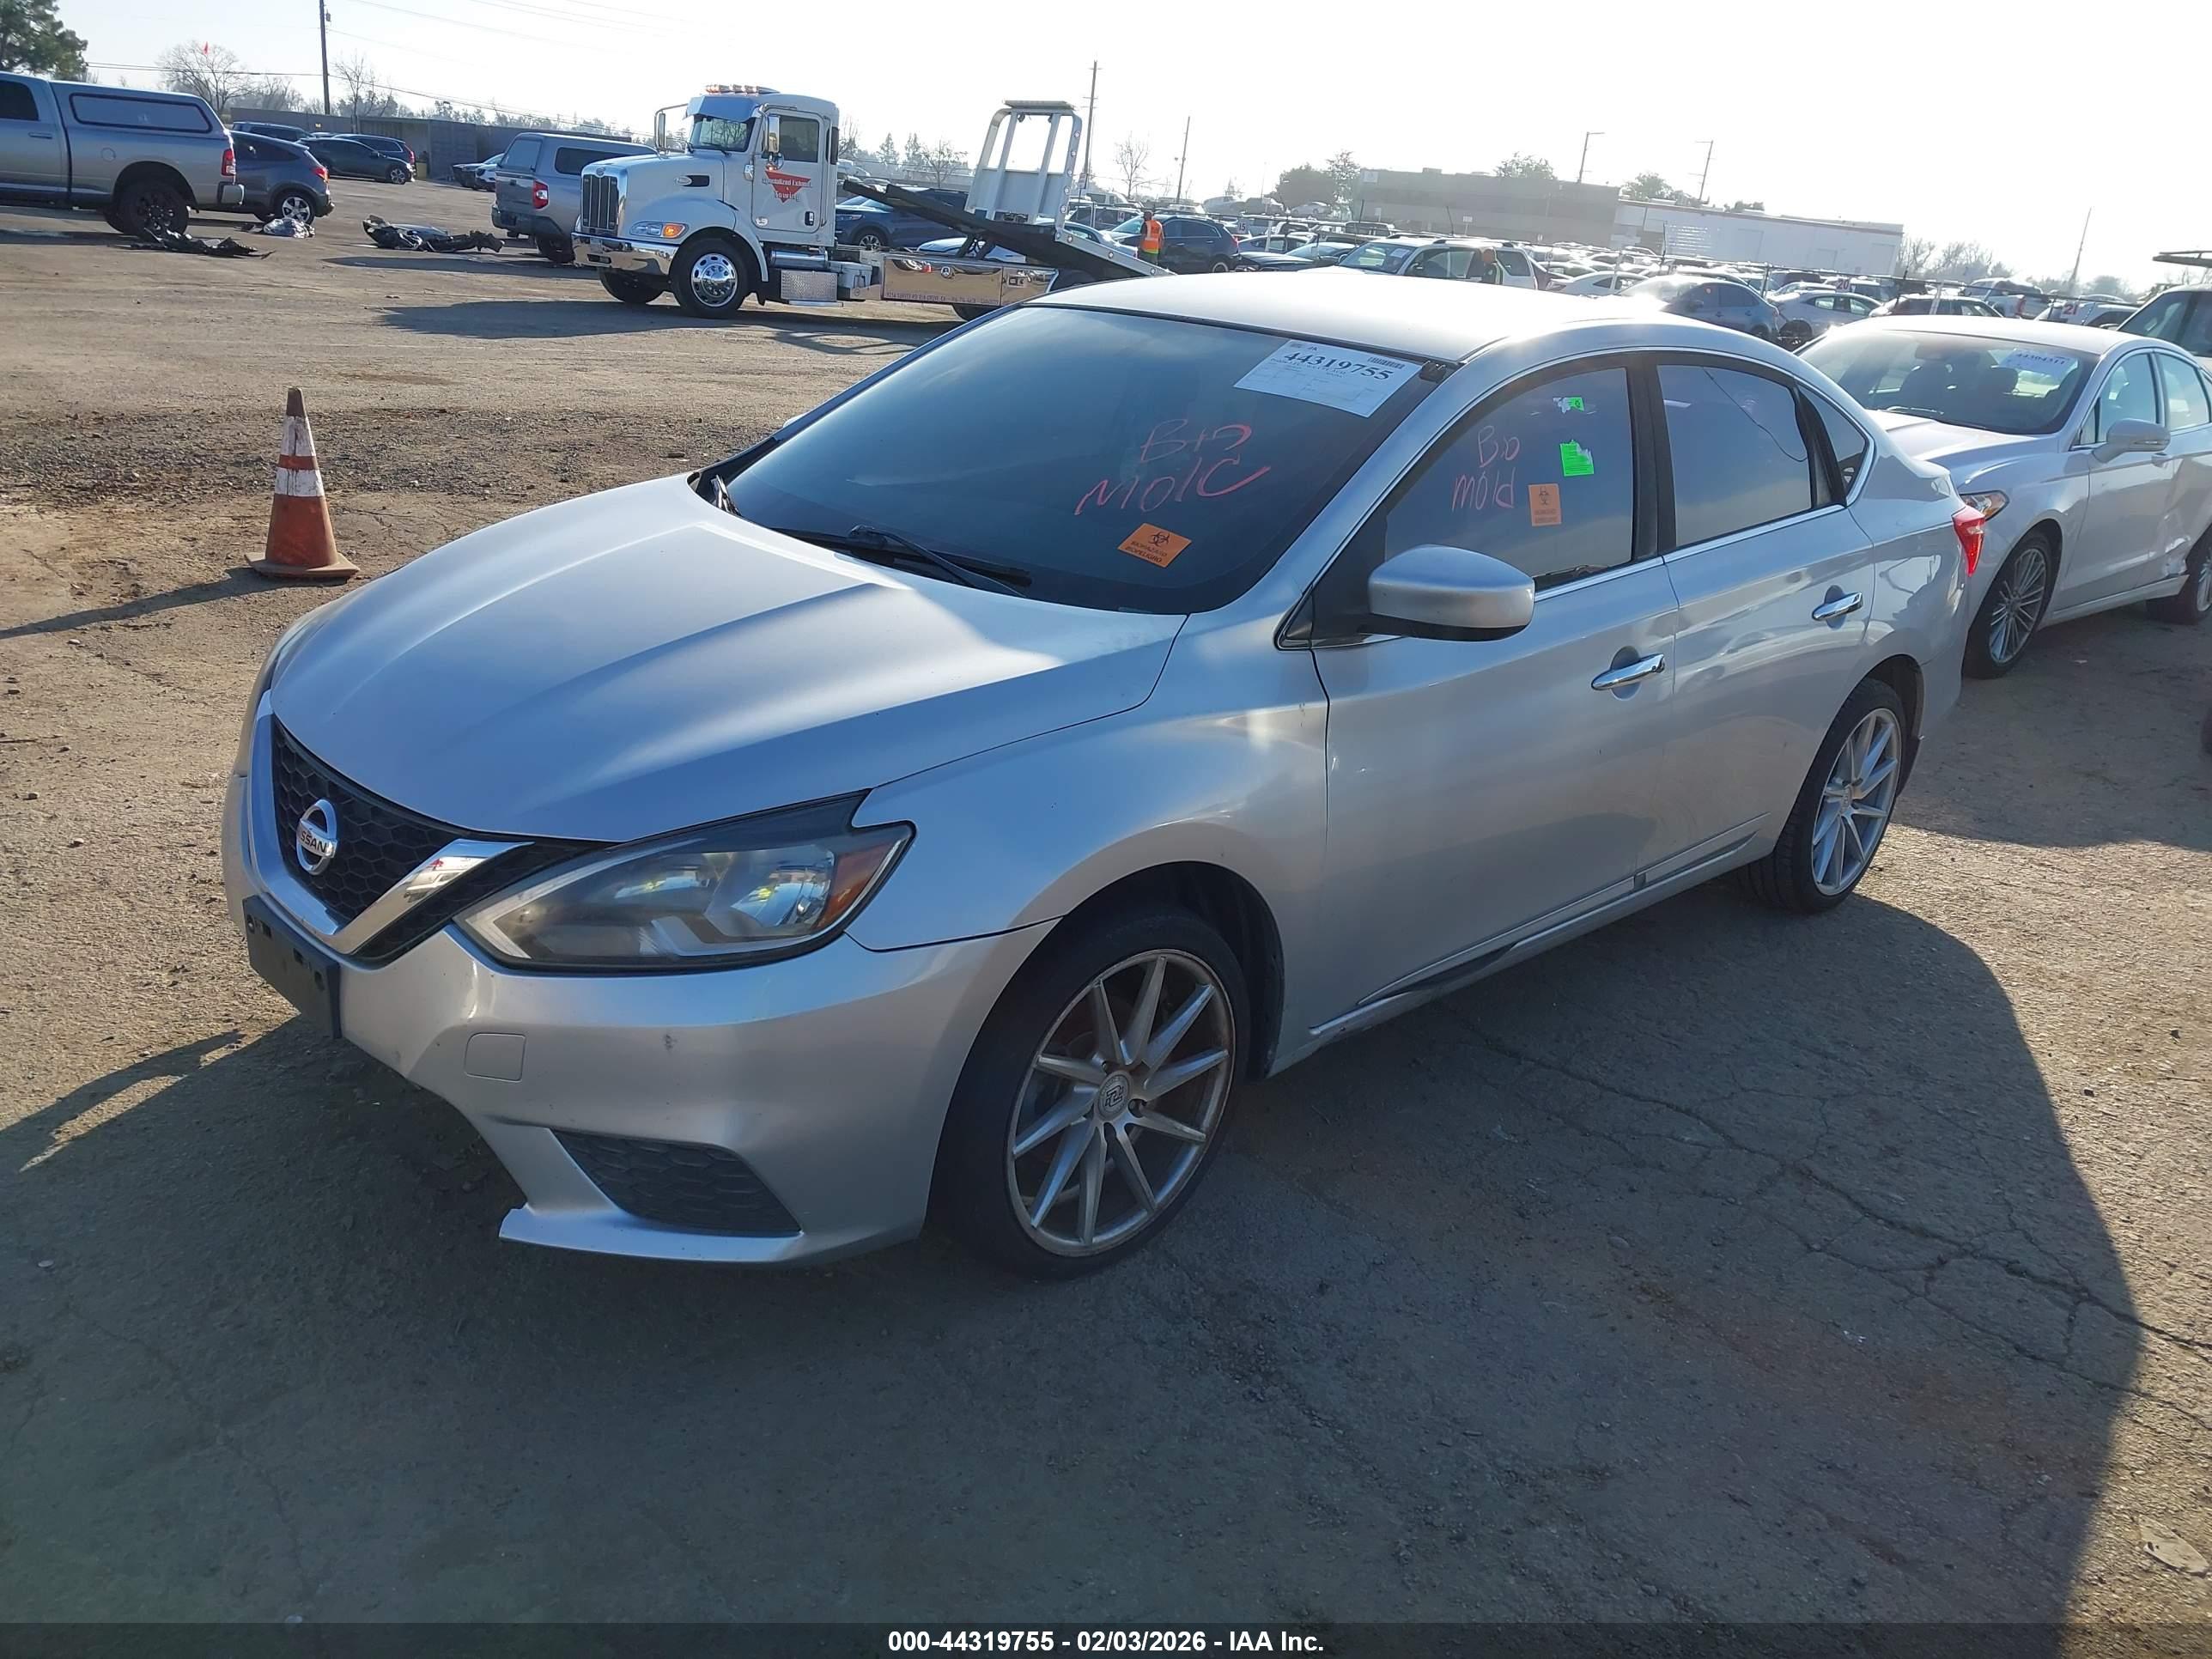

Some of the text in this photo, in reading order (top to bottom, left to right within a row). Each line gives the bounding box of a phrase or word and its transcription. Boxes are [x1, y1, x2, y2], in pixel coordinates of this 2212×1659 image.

[1837, 278, 1850, 289] 20
[2063, 302, 2077, 314] 21
[1285, 352, 1394, 380] 44319755
[300, 830, 326, 853] SSAN
